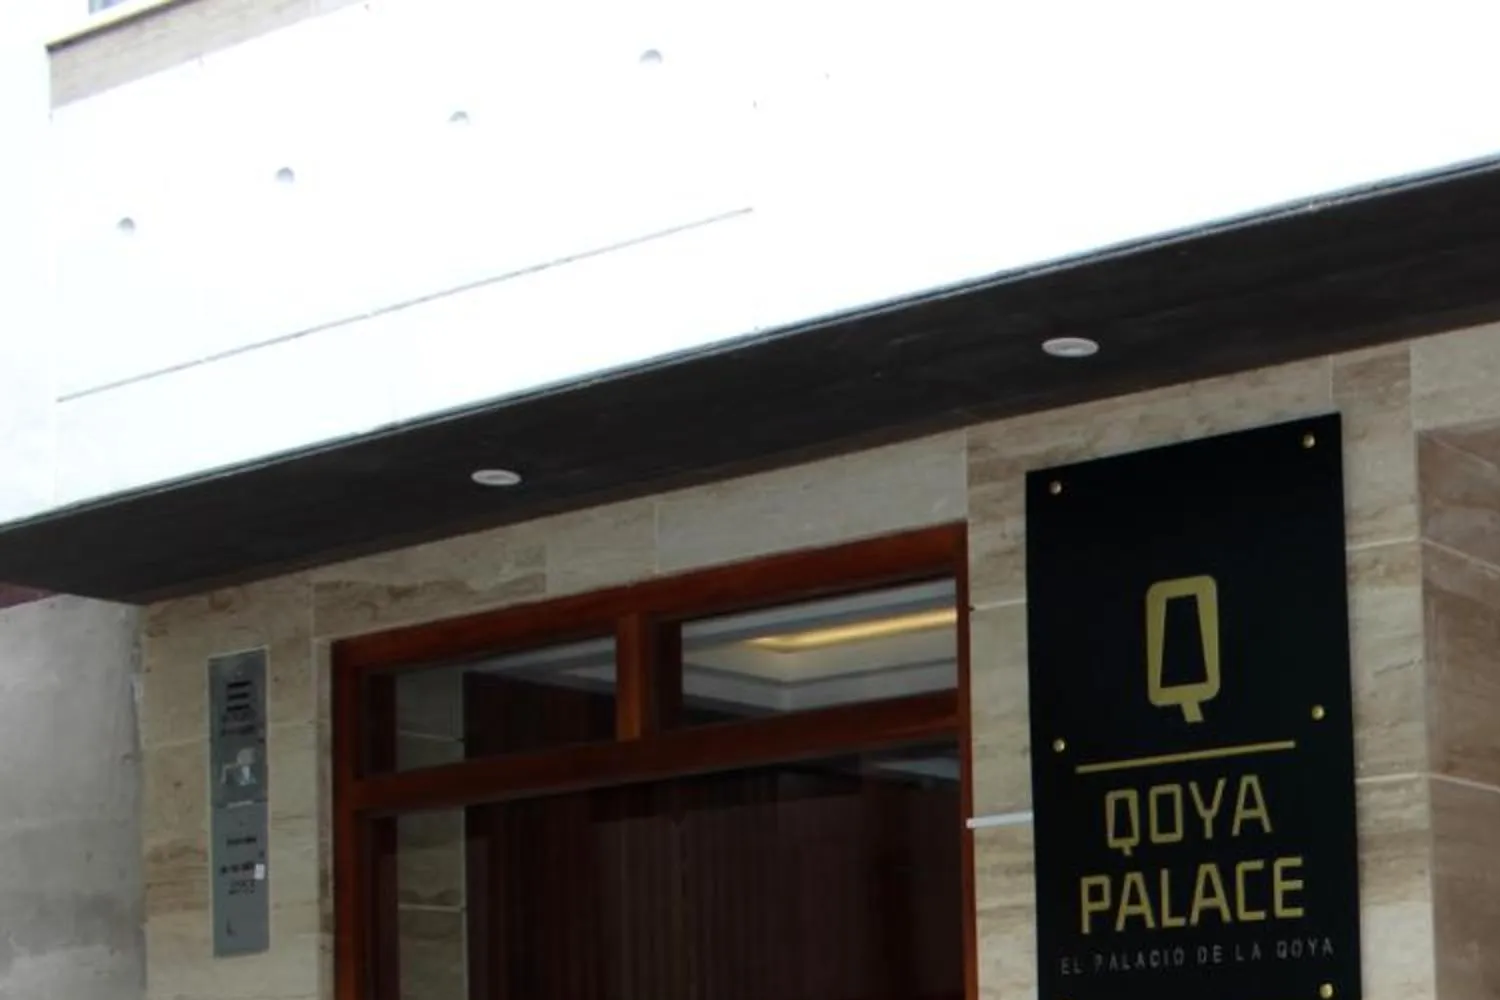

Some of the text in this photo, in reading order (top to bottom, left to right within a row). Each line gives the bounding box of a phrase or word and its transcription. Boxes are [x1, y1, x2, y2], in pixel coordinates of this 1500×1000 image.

[1106, 774, 1272, 856] QOYA
[1080, 857, 1305, 934] PALACE
[1060, 937, 1334, 975] EL PALACIO DE LA QOYA
